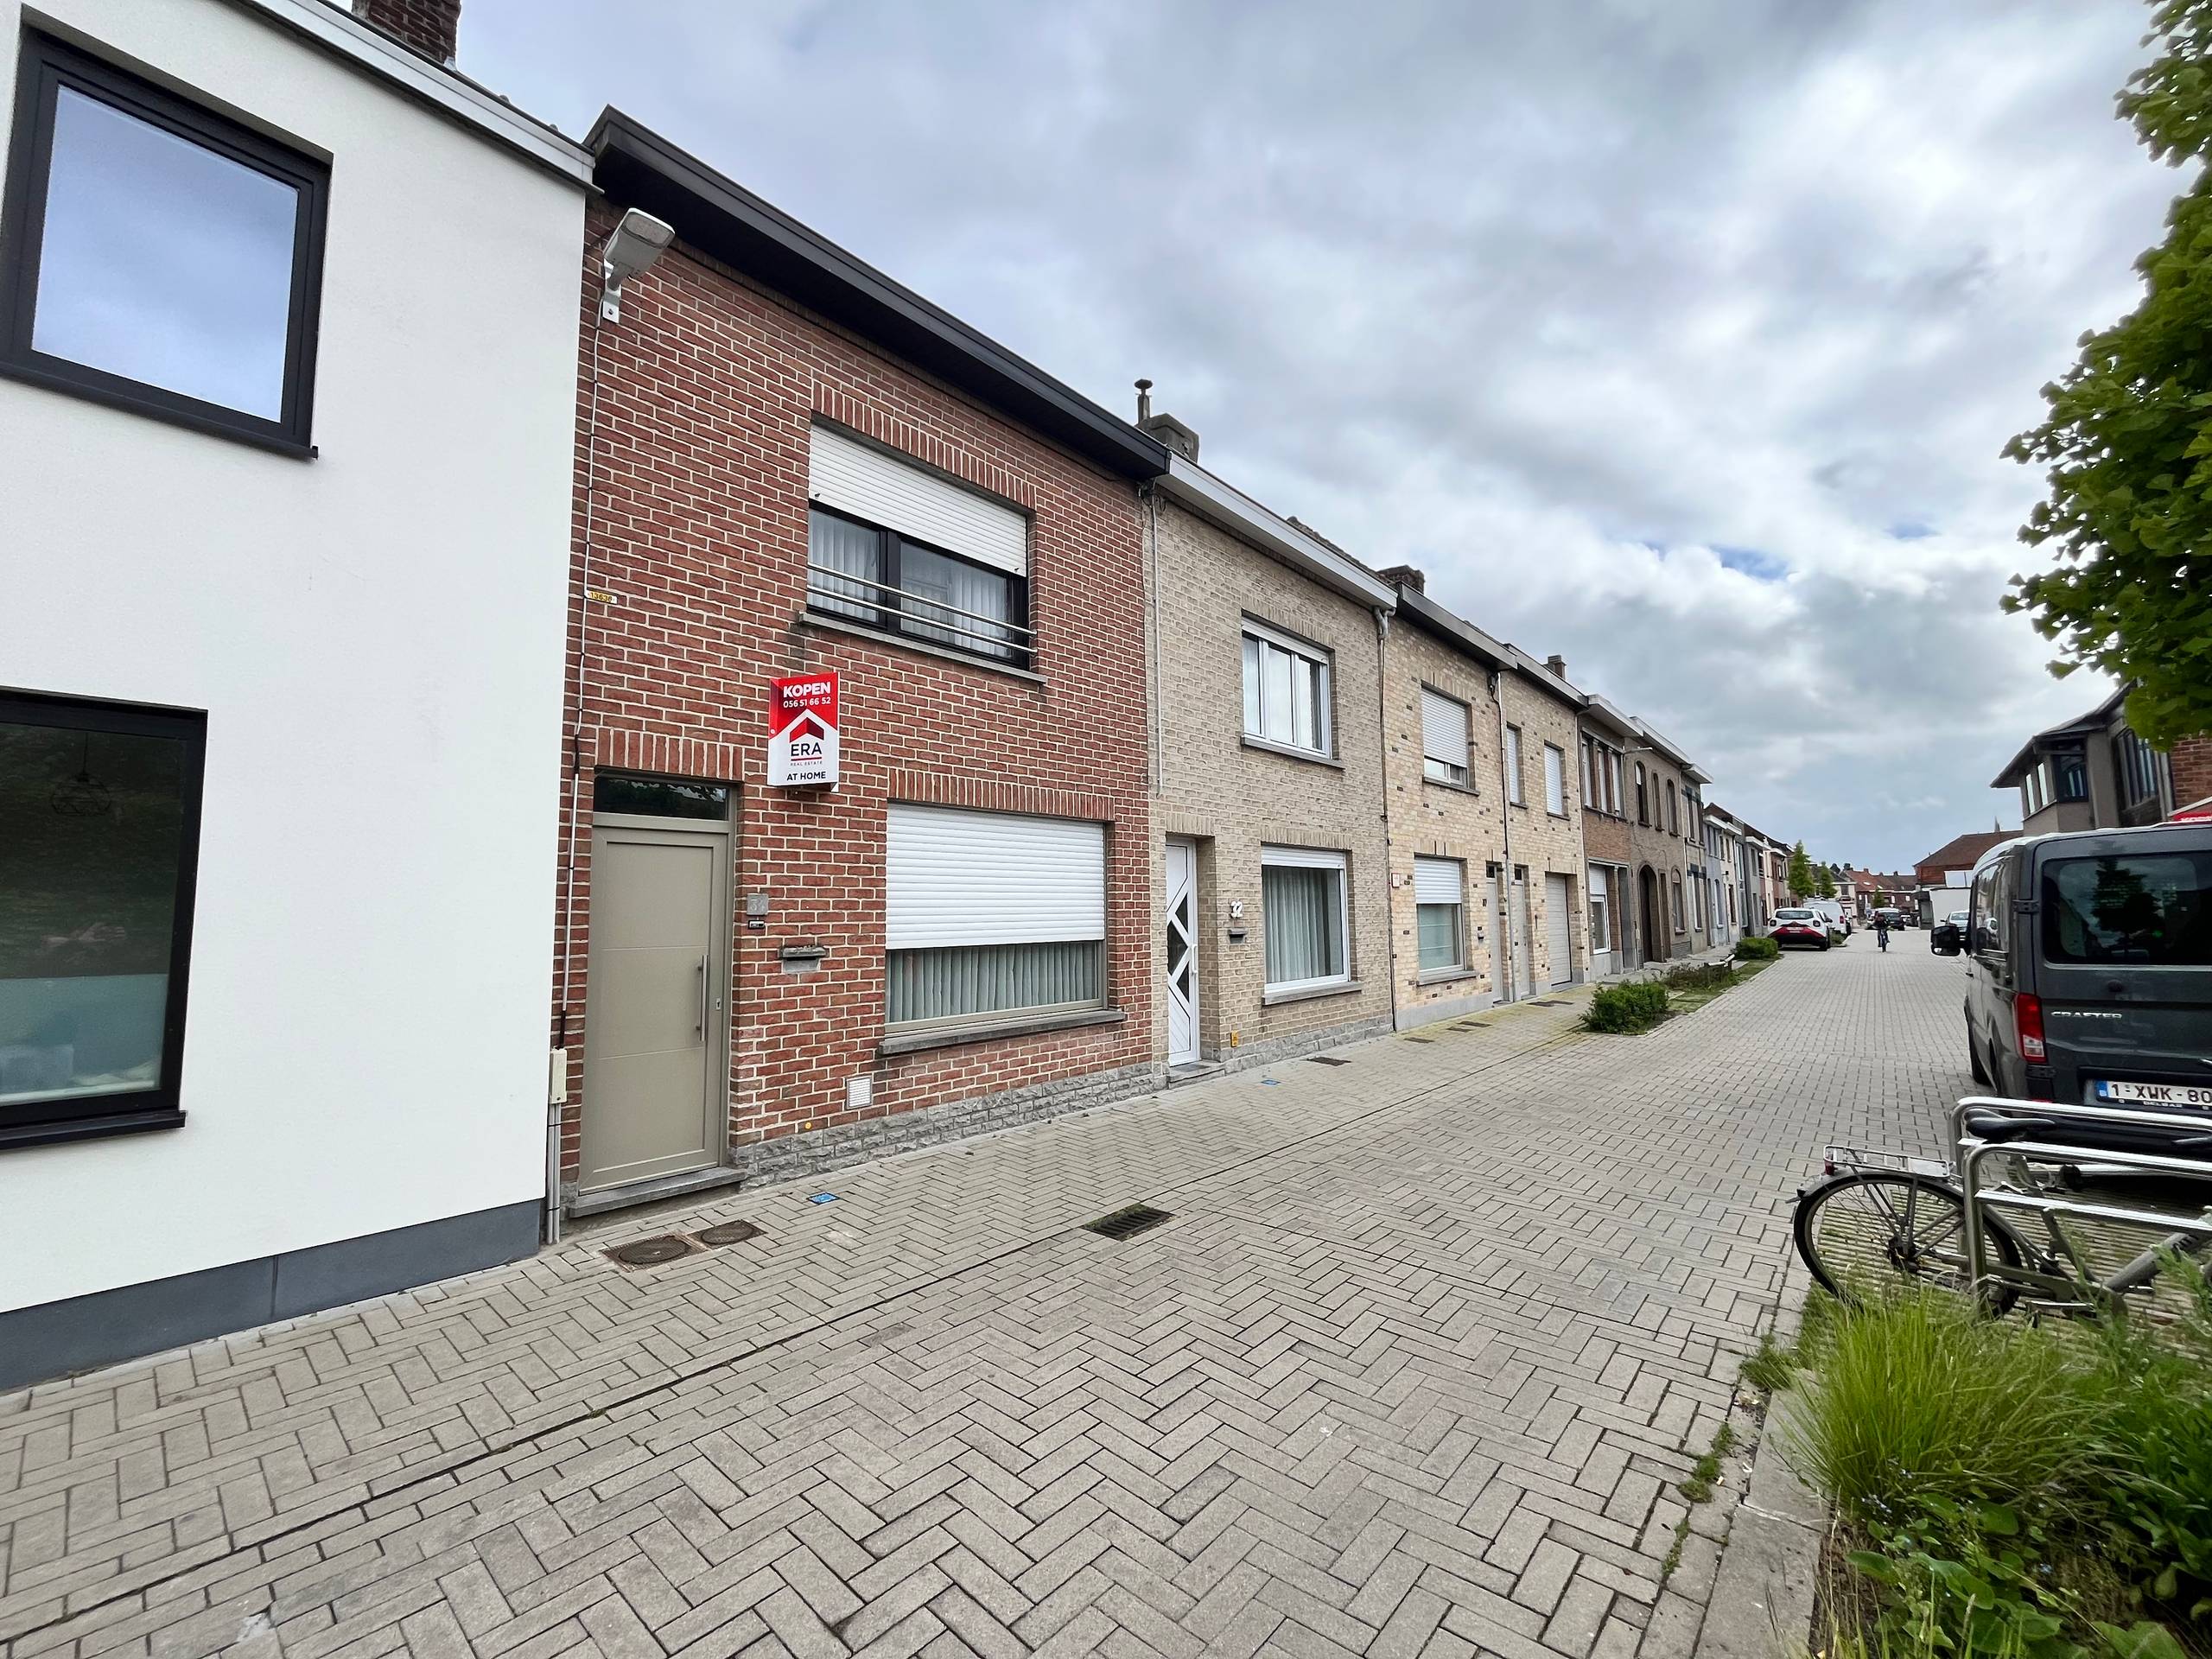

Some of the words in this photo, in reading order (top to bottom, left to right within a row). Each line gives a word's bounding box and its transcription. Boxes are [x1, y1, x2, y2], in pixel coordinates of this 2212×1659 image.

[783, 682, 830, 698] KOPEN
[783, 700, 798, 709] 056
[809, 697, 819, 706] 66
[791, 742, 822, 756] ERA
[800, 771, 826, 780] HOME
